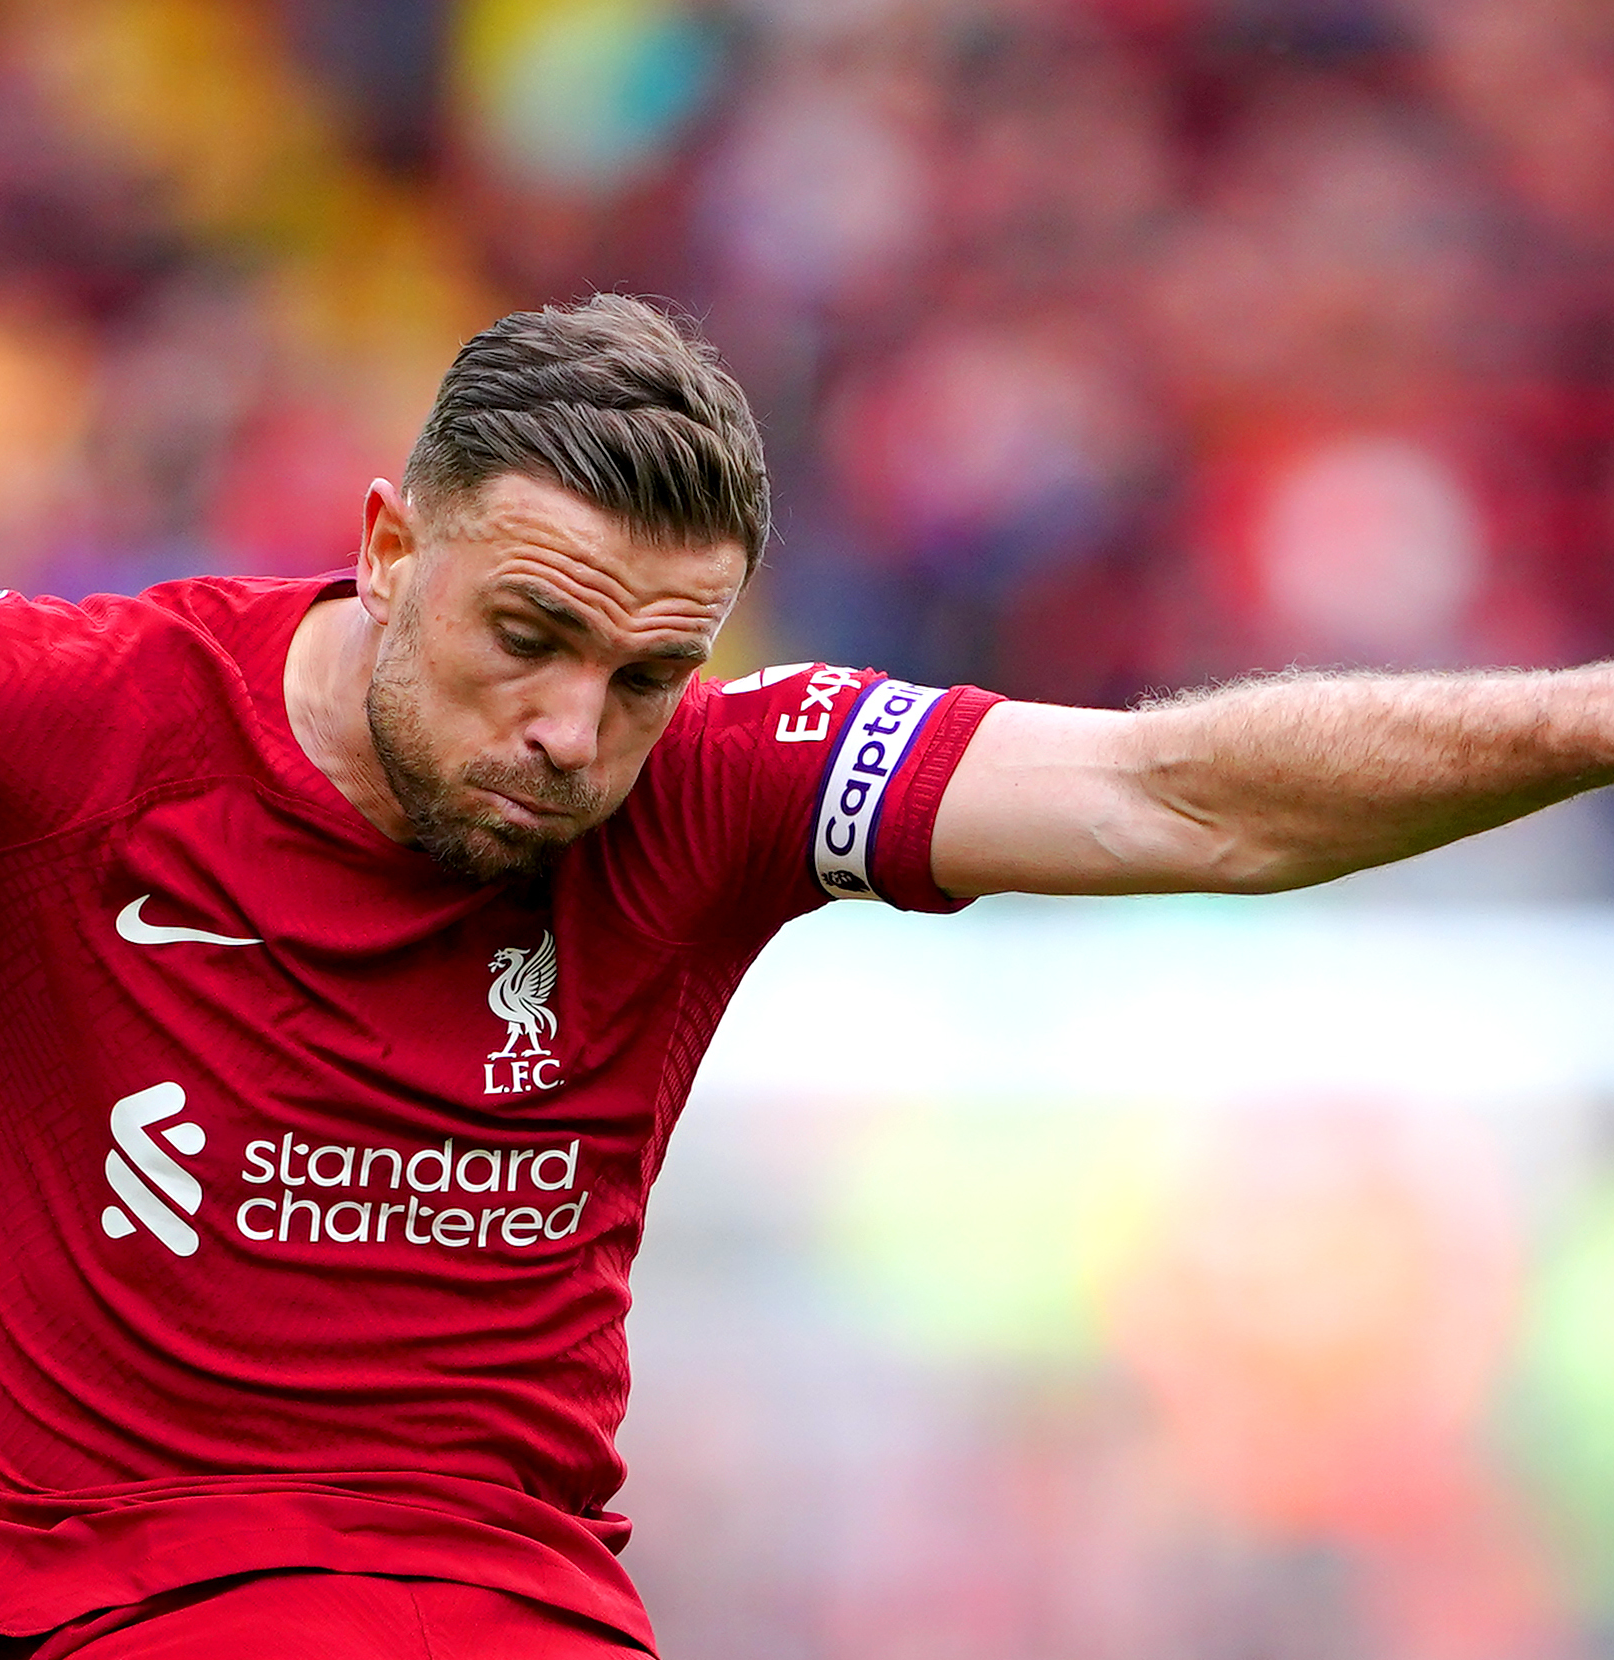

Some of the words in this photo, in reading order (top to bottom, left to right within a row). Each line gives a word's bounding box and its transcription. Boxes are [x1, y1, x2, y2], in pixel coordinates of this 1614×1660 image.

[483, 1058, 565, 1095] L.F.C.
[241, 1131, 580, 1193] standard
[235, 1188, 589, 1248] chartered
